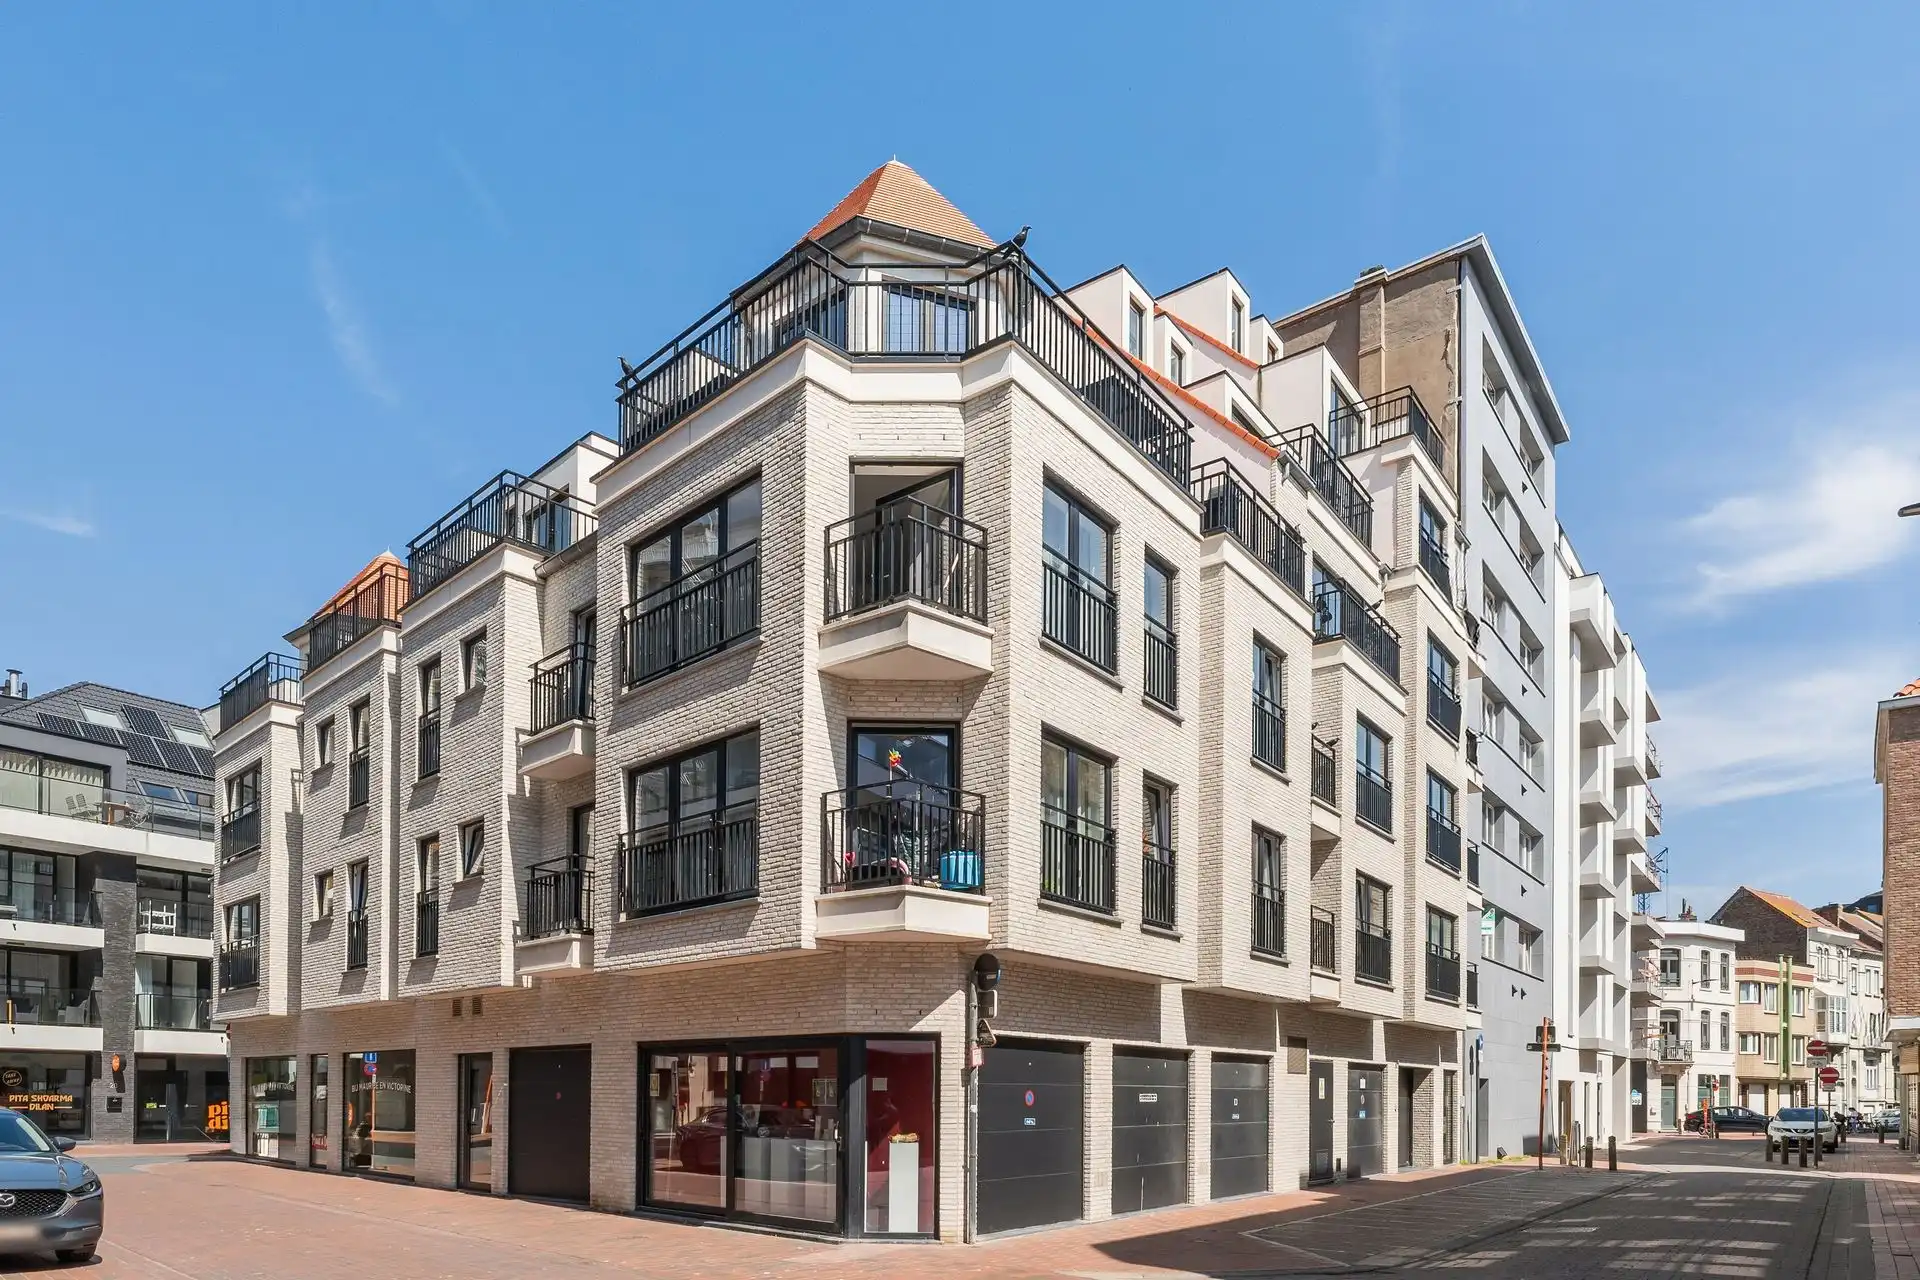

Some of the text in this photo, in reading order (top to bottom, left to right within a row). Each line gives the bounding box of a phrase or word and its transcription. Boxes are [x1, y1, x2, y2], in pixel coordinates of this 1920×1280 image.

[9, 1094, 73, 1102] PITA SHOARMA
[29, 1103, 54, 1111] DILAN
